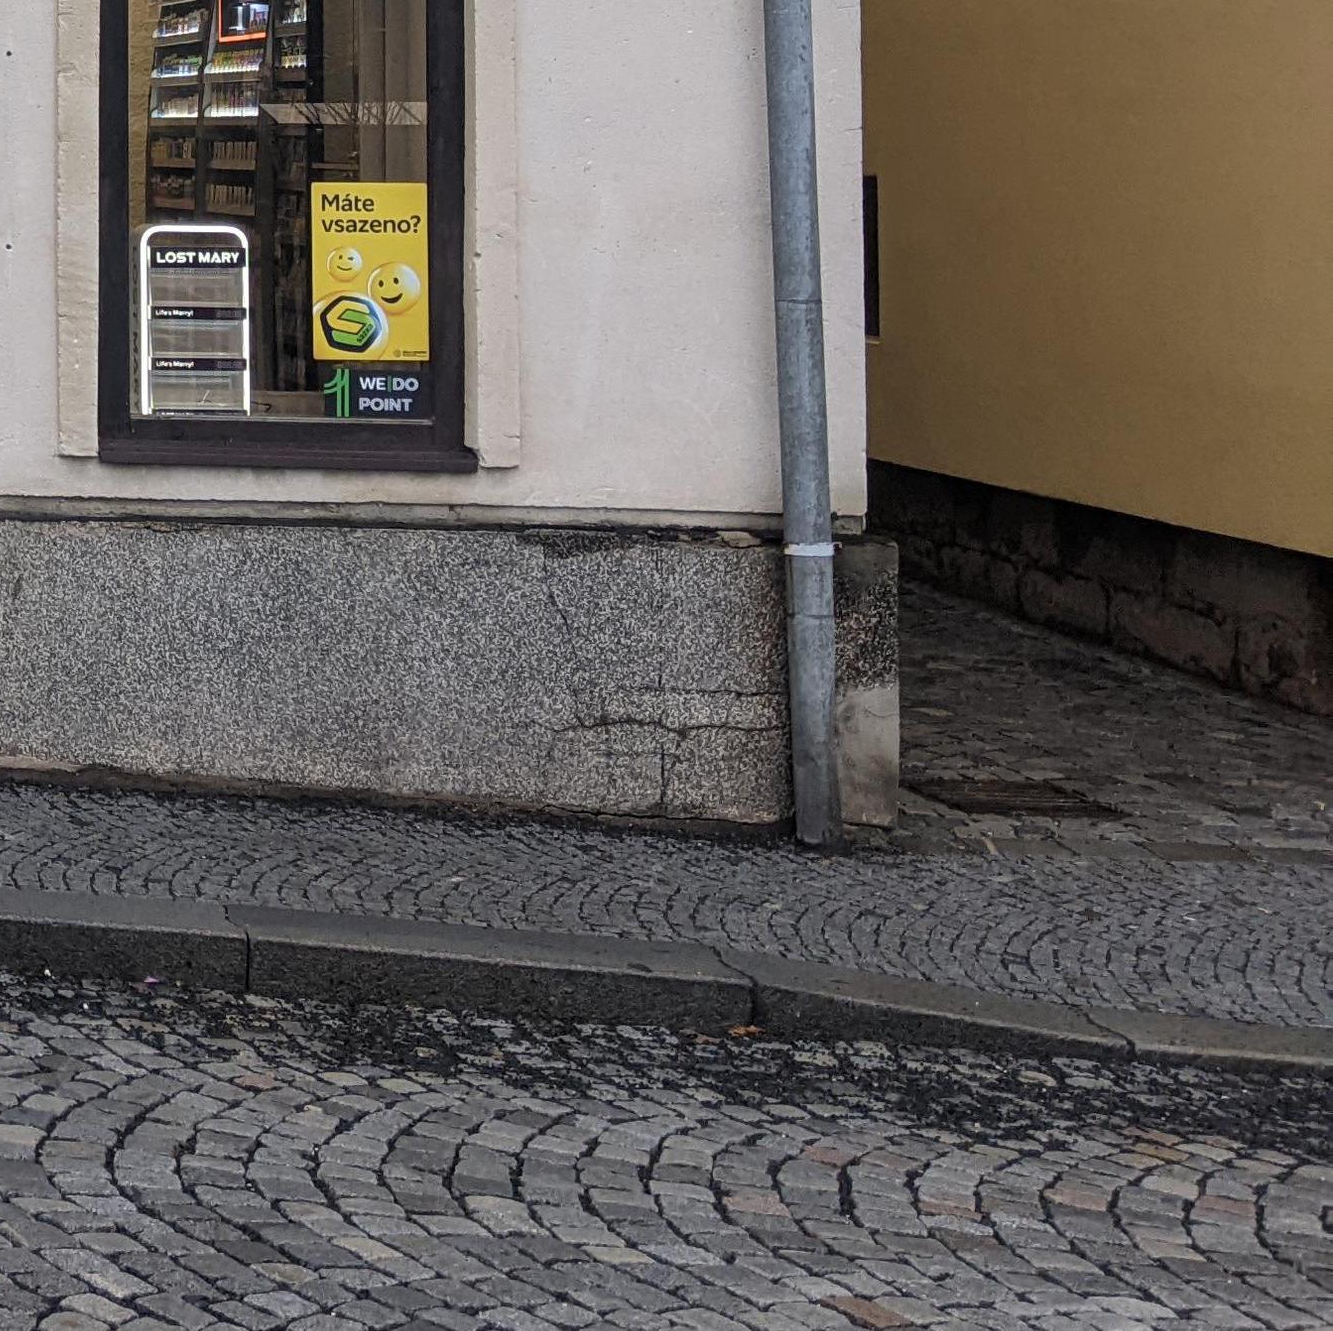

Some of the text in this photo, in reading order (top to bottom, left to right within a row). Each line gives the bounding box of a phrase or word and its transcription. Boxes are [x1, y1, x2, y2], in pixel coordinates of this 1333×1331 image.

[321, 193, 375, 212] Máte
[321, 215, 422, 234] vsazeno?
[156, 251, 240, 264] LOST MARY
[358, 397, 414, 413] POINT
